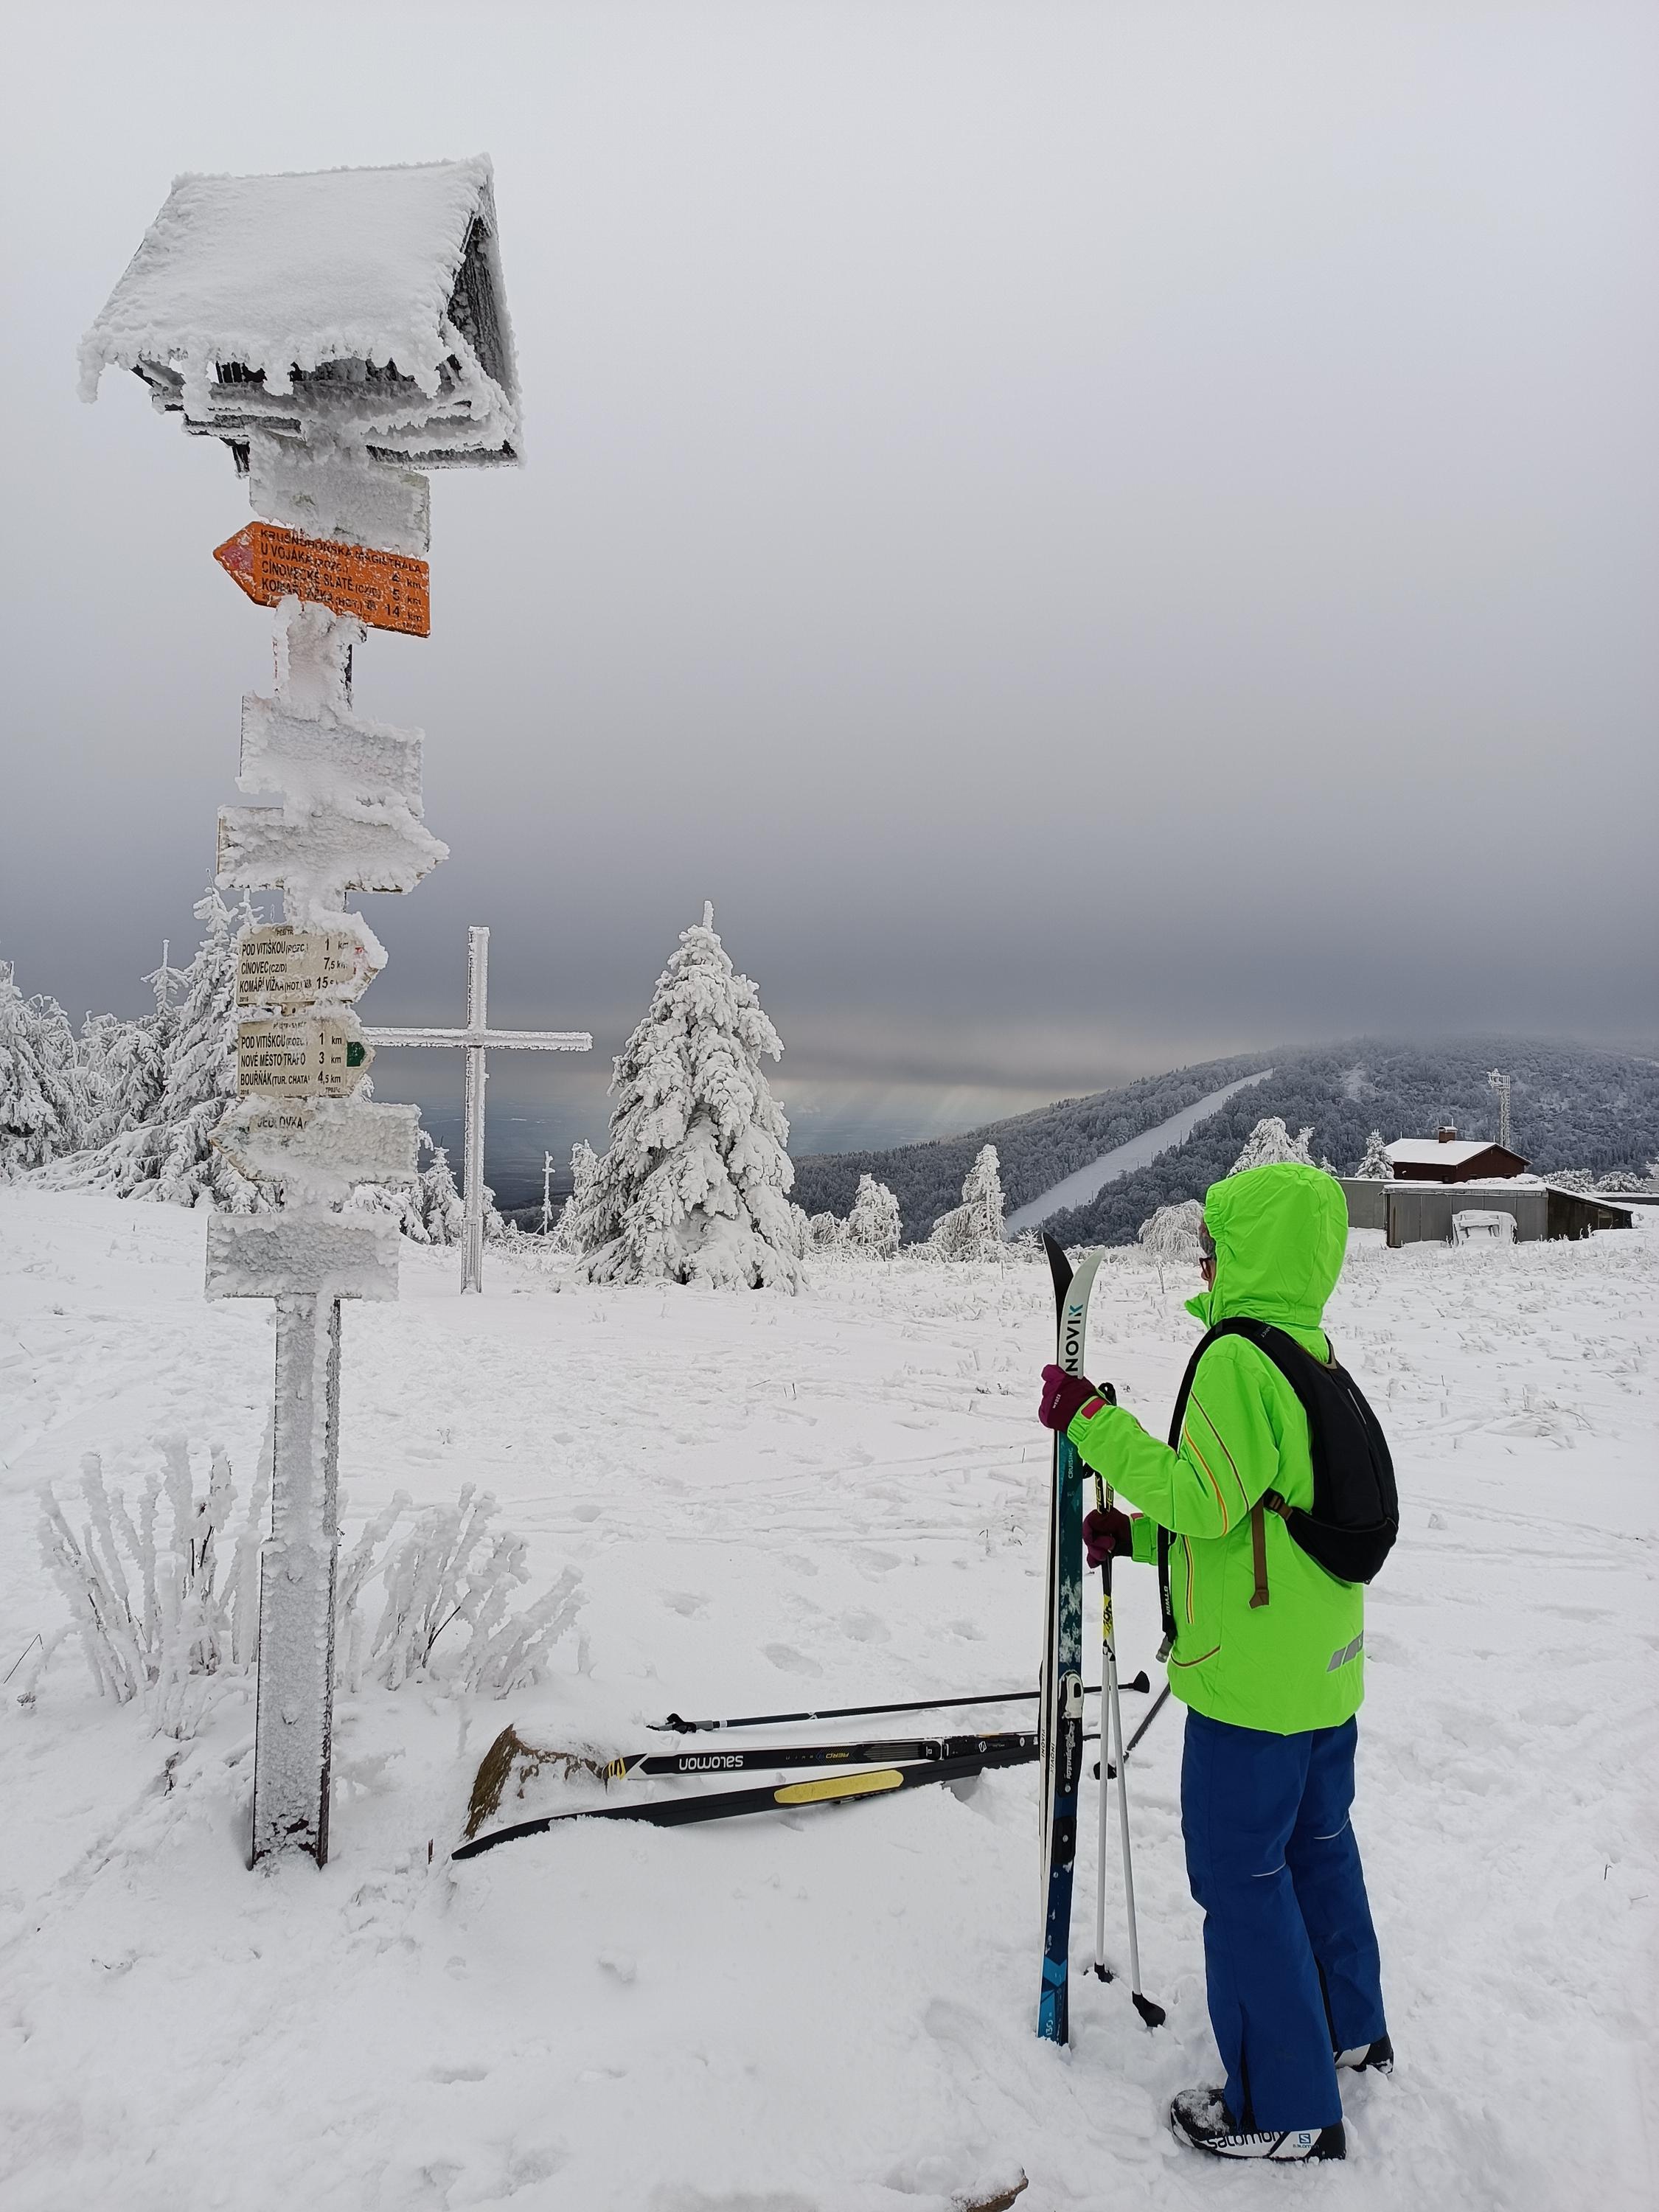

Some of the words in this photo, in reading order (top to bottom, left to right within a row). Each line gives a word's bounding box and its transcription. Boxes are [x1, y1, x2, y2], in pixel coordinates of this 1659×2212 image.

[406, 578, 422, 589] km
[406, 594, 422, 605] km
[384, 603, 400, 618] 14
[242, 943, 256, 956] POD
[257, 939, 286, 956] VITIŠKOU
[324, 938, 330, 950] 1
[241, 959, 269, 975] CÍNOVEC
[241, 1035, 255, 1048] POD
[256, 1032, 286, 1048] VITIŠKOU
[319, 1032, 324, 1046] 1
[331, 1035, 342, 1045] km
[240, 1052, 259, 1068] NOVÉ
[260, 1051, 282, 1067] MĚSTO
[319, 1051, 324, 1065] 3
[330, 1055, 341, 1064] km
[330, 1074, 341, 1084] km
